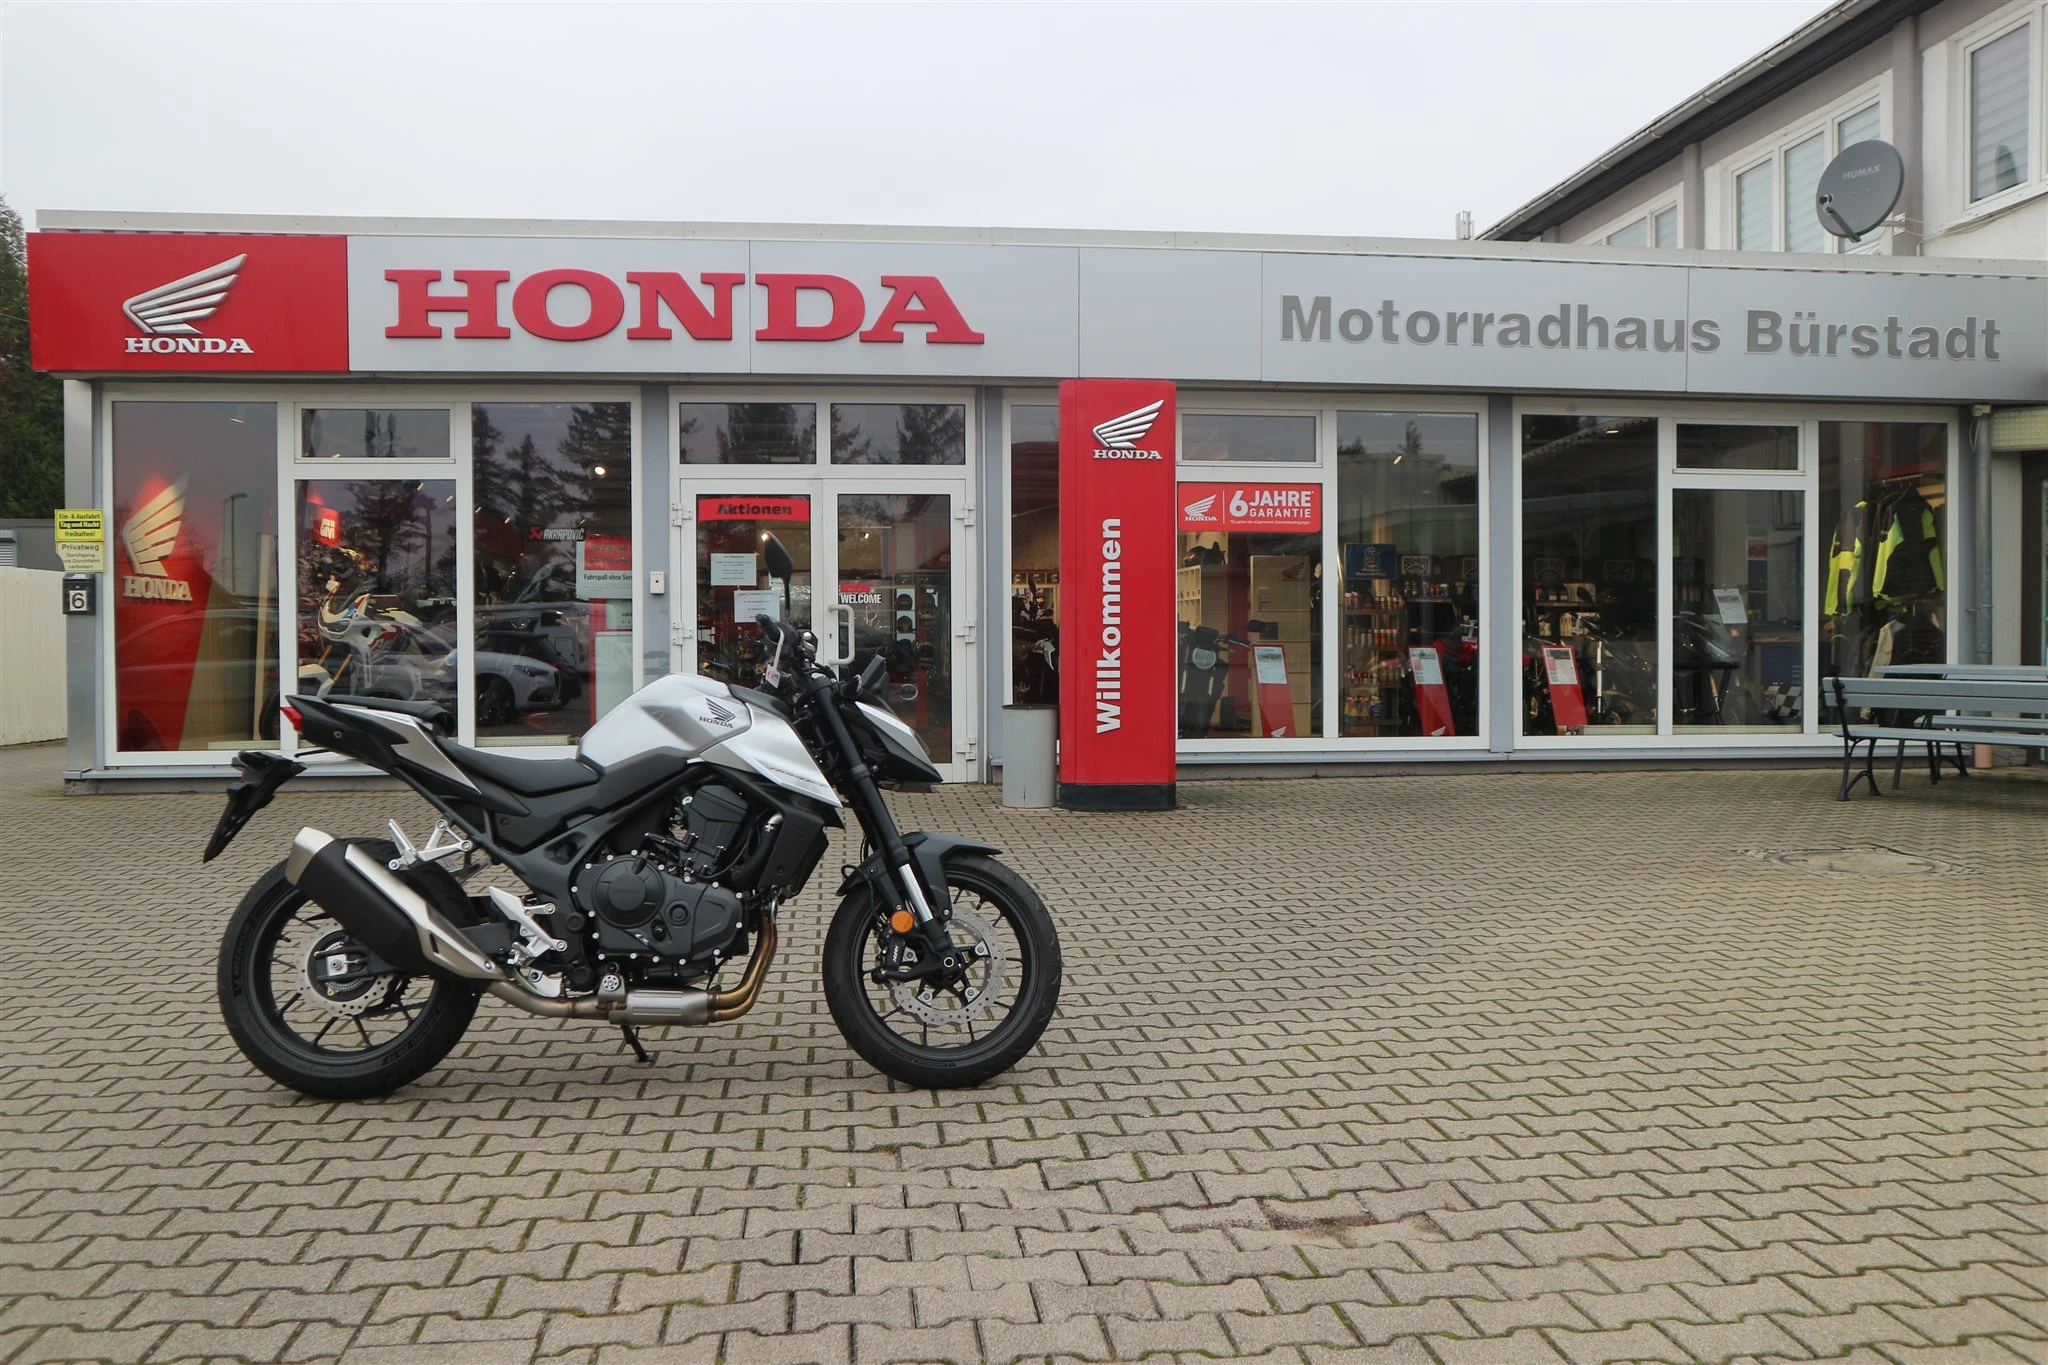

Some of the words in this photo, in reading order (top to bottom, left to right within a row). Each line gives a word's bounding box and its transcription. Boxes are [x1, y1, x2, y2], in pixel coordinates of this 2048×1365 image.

[1842, 164, 1880, 180] HUMAX
[385, 269, 984, 343] HONDA
[1281, 294, 1721, 353] Motorradhaus
[1744, 309, 2001, 361] Bürstadt
[125, 337, 255, 354] HONDA
[1093, 449, 1163, 460] HONDA
[717, 503, 793, 516] Aktionen
[1229, 490, 1249, 517] 6
[1249, 508, 1312, 518] GARANTIE
[61, 543, 99, 551] Privatweg
[608, 573, 622, 581] ohne
[123, 575, 193, 602] HONDA
[71, 592, 85, 609] 6
[840, 593, 882, 604] WELCOME
[1096, 518, 1121, 734] Willkommen
[699, 715, 734, 729] HONDA
